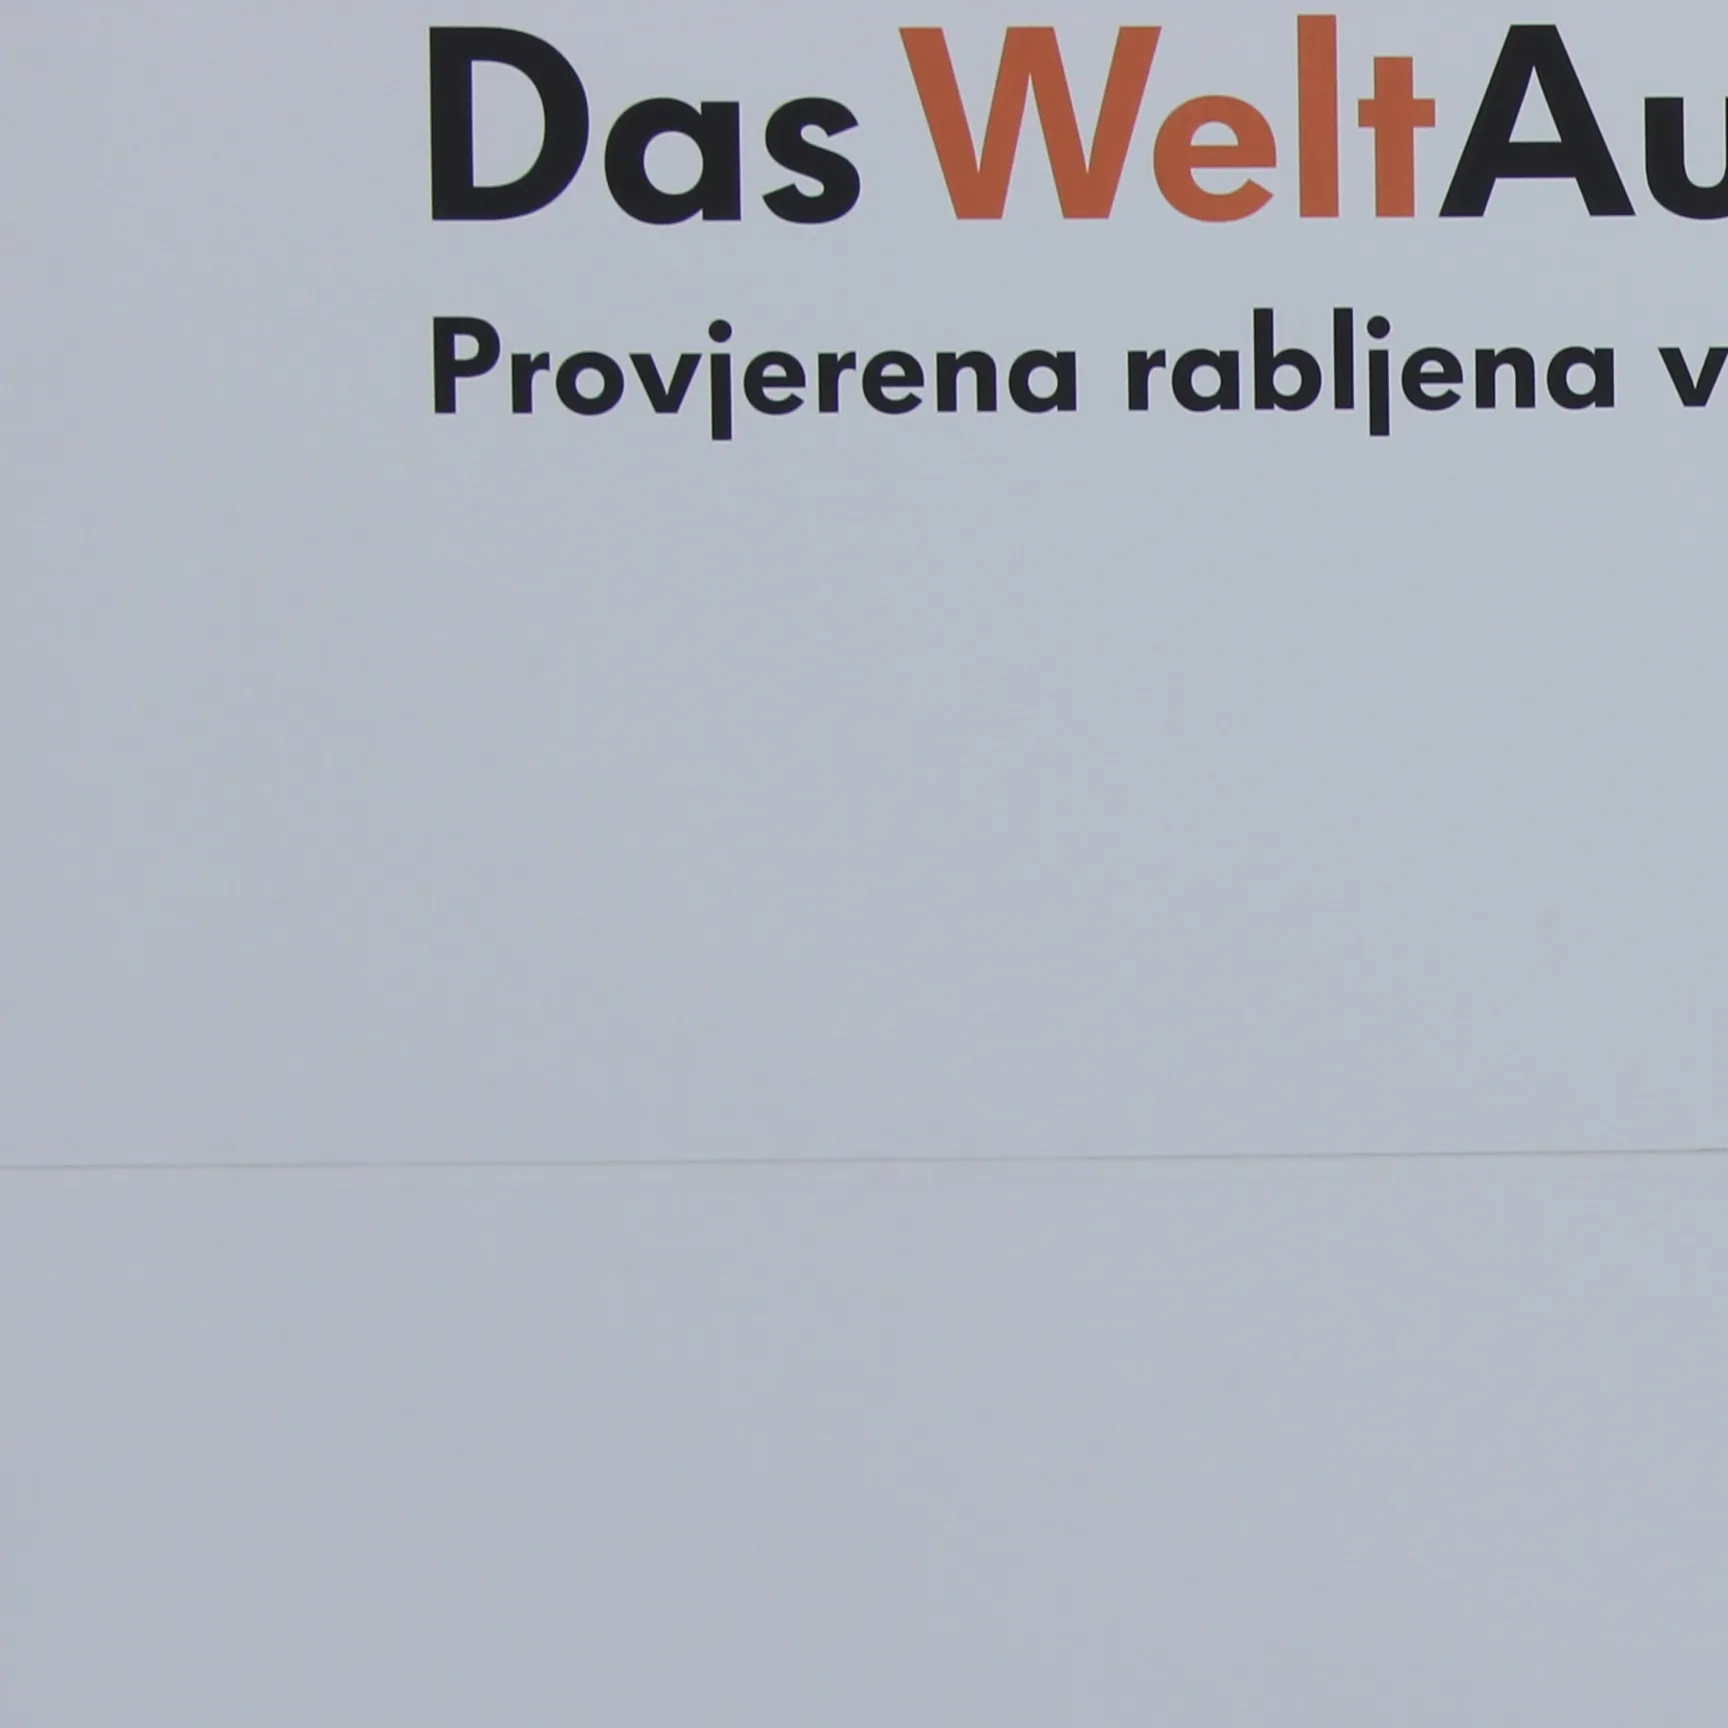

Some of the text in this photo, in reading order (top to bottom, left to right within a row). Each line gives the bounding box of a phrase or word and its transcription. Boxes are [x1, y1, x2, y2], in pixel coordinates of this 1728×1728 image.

[428, 26, 861, 226] Das
[432, 316, 1077, 441] Provjerena
[1127, 302, 1615, 437] rabljena
